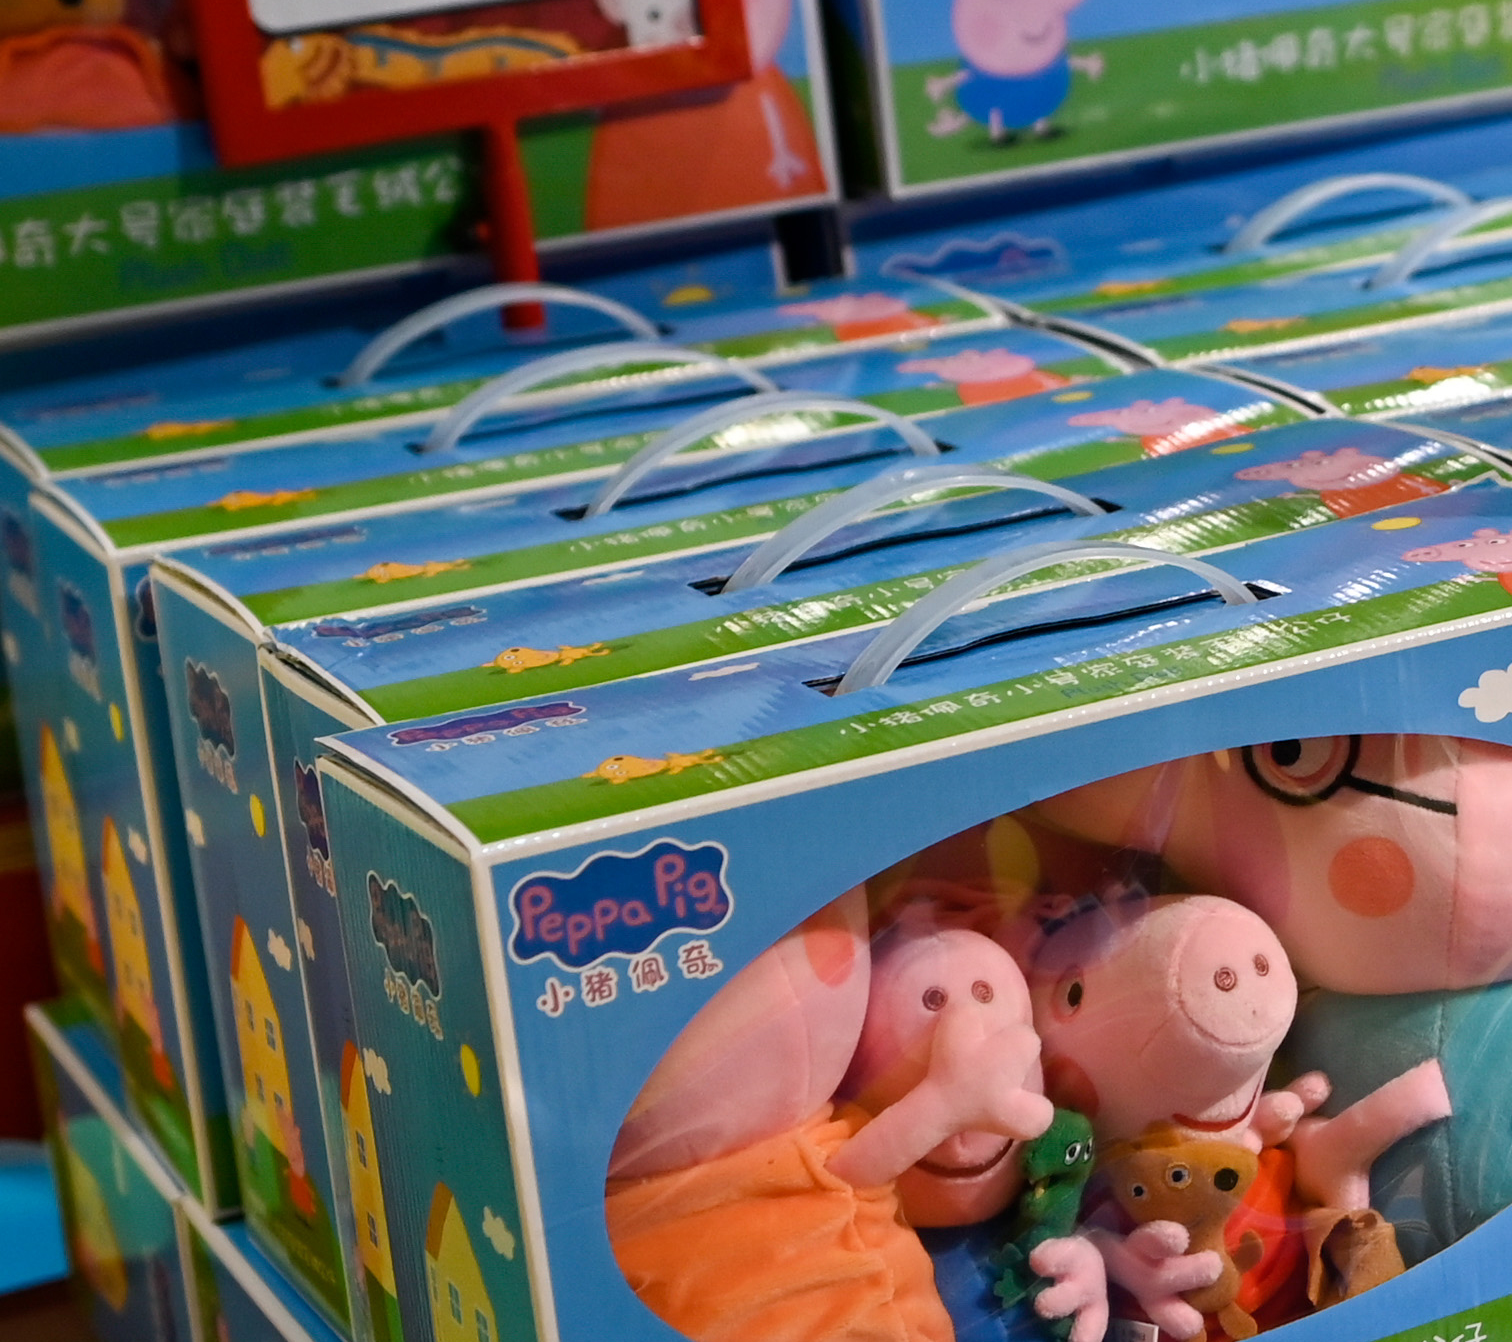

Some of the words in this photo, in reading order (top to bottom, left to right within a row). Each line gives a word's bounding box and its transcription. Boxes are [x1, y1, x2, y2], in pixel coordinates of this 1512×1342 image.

[519, 885, 652, 956] Peppa
[653, 853, 726, 919] Pig
[538, 941, 722, 1015] 小猪佩奇
